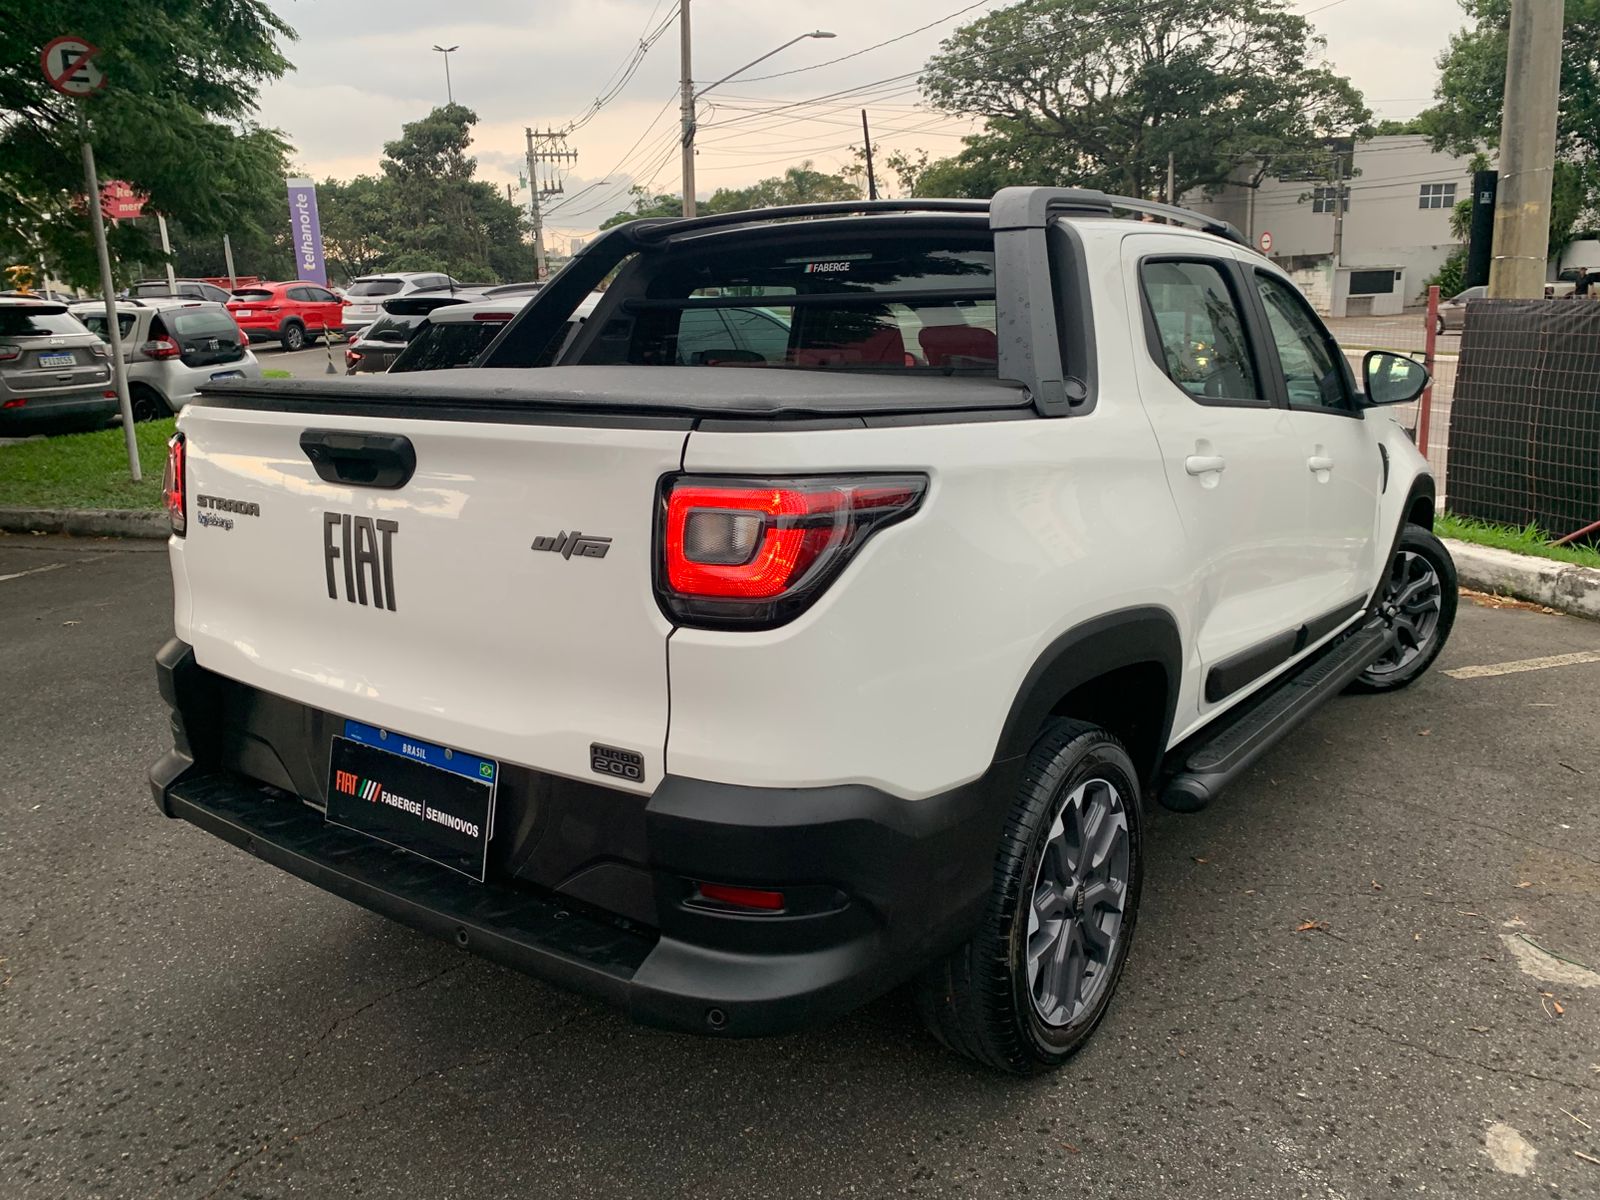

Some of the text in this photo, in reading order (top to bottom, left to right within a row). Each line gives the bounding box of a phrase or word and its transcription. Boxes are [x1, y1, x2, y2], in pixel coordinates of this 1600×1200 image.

[61, 49, 90, 83] E
[296, 193, 316, 271] telhanorte
[813, 262, 851, 272] FABERGE
[196, 494, 260, 517] STRADA
[323, 511, 399, 612] FIAT
[402, 743, 427, 760] BRASIL
[593, 747, 641, 765] TURBO
[593, 758, 640, 778] 200
[335, 769, 479, 838] FIAT FABERGE SEMINOVOS
